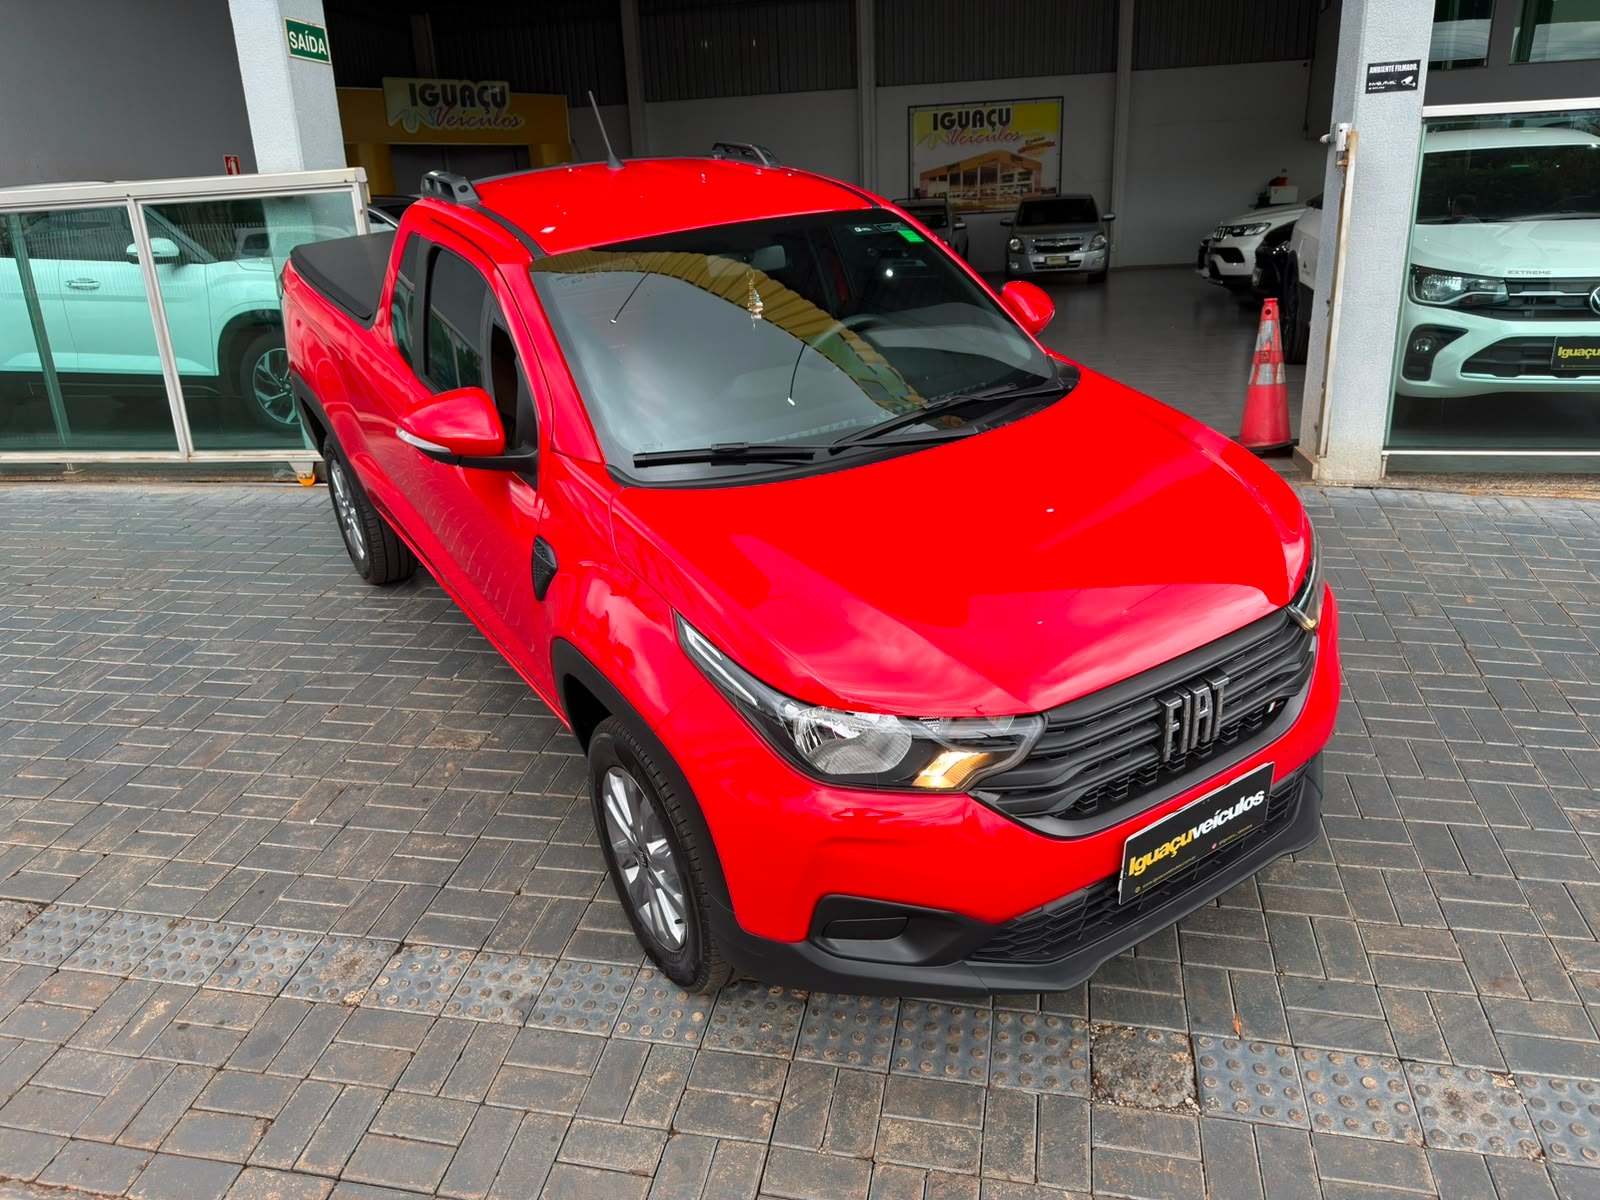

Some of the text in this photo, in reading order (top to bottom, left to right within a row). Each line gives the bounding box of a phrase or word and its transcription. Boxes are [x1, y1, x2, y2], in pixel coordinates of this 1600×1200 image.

[289, 30, 327, 55] SAÍDA
[1369, 65, 1394, 74] AMBIENTE
[408, 82, 506, 113] IGUAÇU
[932, 107, 1011, 132] IGUAÇU
[1162, 676, 1229, 762] FIAT
